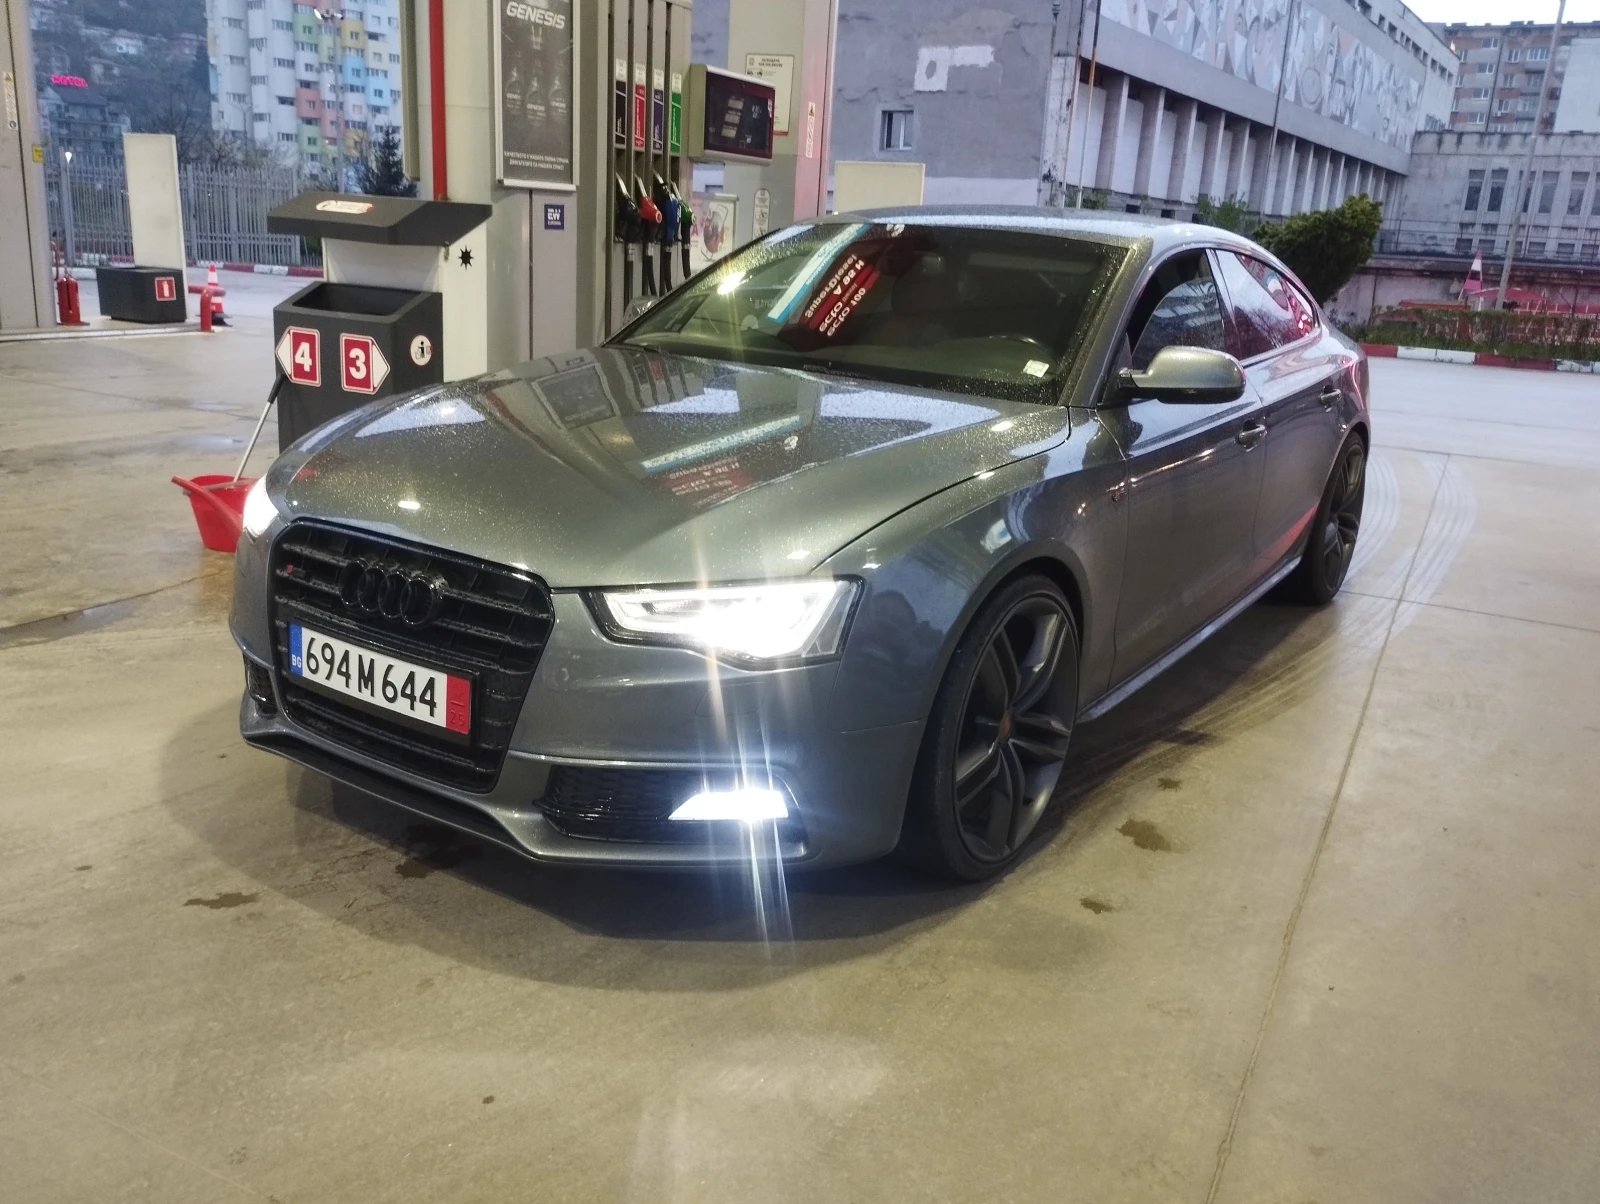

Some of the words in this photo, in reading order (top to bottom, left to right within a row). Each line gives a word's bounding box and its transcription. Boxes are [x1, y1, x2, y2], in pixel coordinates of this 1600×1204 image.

[506, 1, 566, 30] GENESIS
[294, 341, 313, 373] 4
[348, 347, 367, 380] 3
[291, 654, 302, 669] BG
